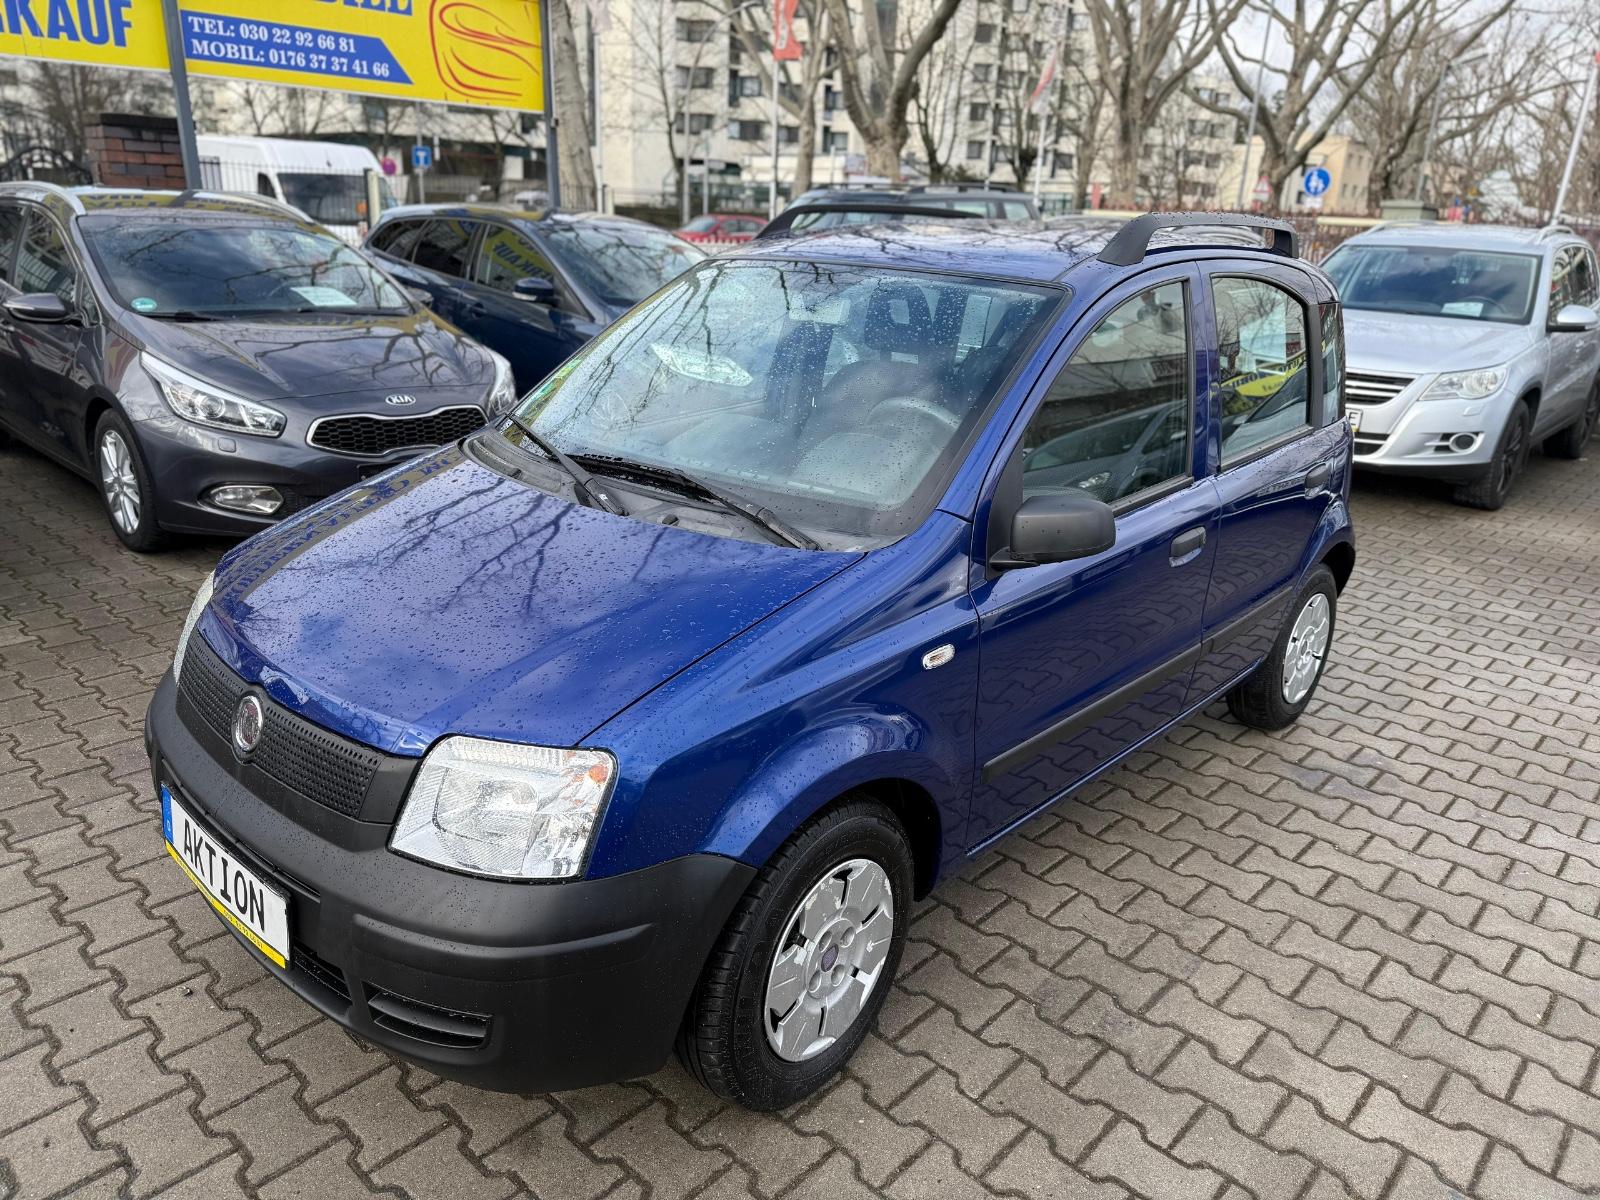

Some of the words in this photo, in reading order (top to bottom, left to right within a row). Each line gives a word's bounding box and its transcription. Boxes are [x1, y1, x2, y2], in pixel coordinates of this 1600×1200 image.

[0, 0, 132, 47] KAUF
[188, 16, 235, 37] TEL:
[239, 23, 268, 41] 030
[272, 27, 292, 44] 22
[295, 31, 314, 47] 92
[317, 35, 336, 50] 66
[338, 37, 356, 52] 81
[191, 39, 265, 62] MOBIL:
[269, 49, 306, 67] 0176
[309, 54, 328, 69] 37
[331, 57, 348, 72] 37
[352, 60, 369, 75] 41
[372, 62, 389, 77] 66
[388, 394, 413, 404] KIA
[184, 818, 265, 932] AKTION
